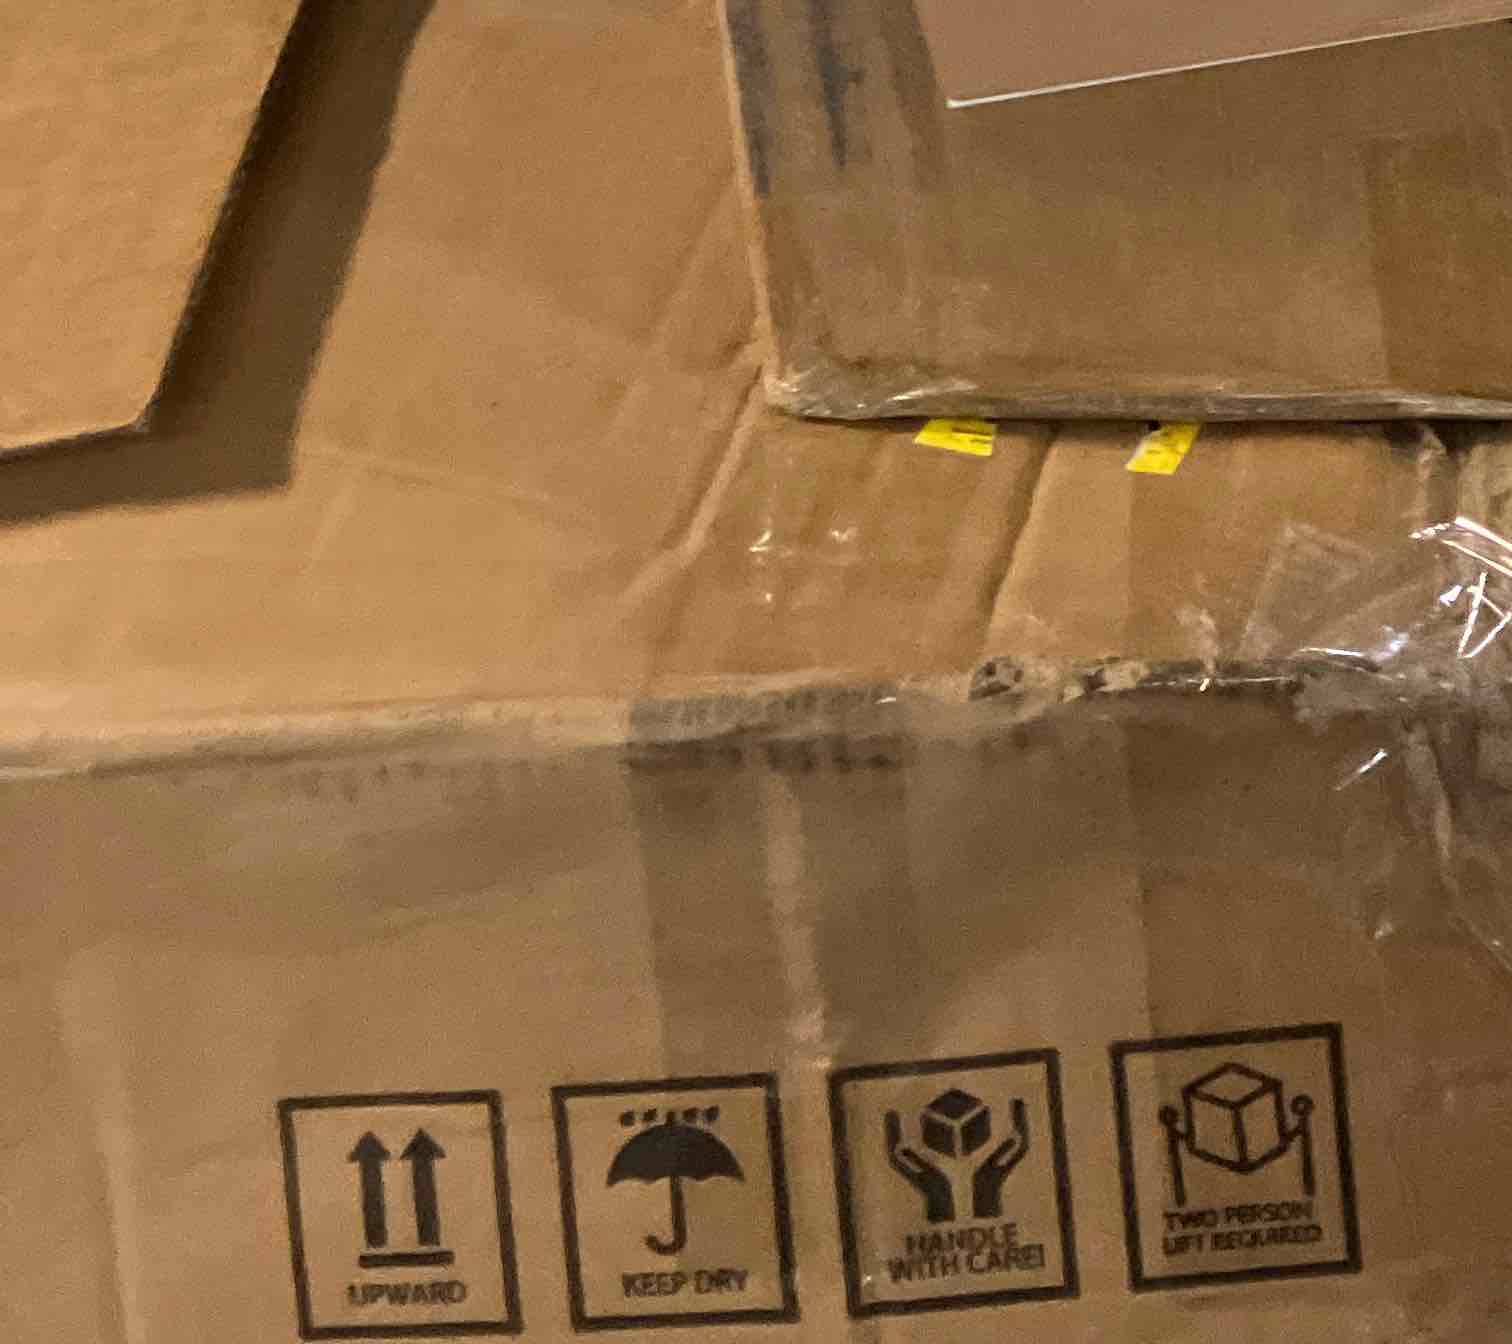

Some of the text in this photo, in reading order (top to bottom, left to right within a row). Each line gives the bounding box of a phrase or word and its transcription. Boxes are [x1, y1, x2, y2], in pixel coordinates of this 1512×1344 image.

[1163, 1200, 1314, 1231] TWO PERSON
[905, 1222, 1018, 1256] HANDLE
[1211, 1224, 1323, 1251] REQUIRED
[888, 1250, 961, 1283] WITH
[346, 1279, 467, 1307] UPWARD
[622, 1268, 748, 1298] KEEP DRY
